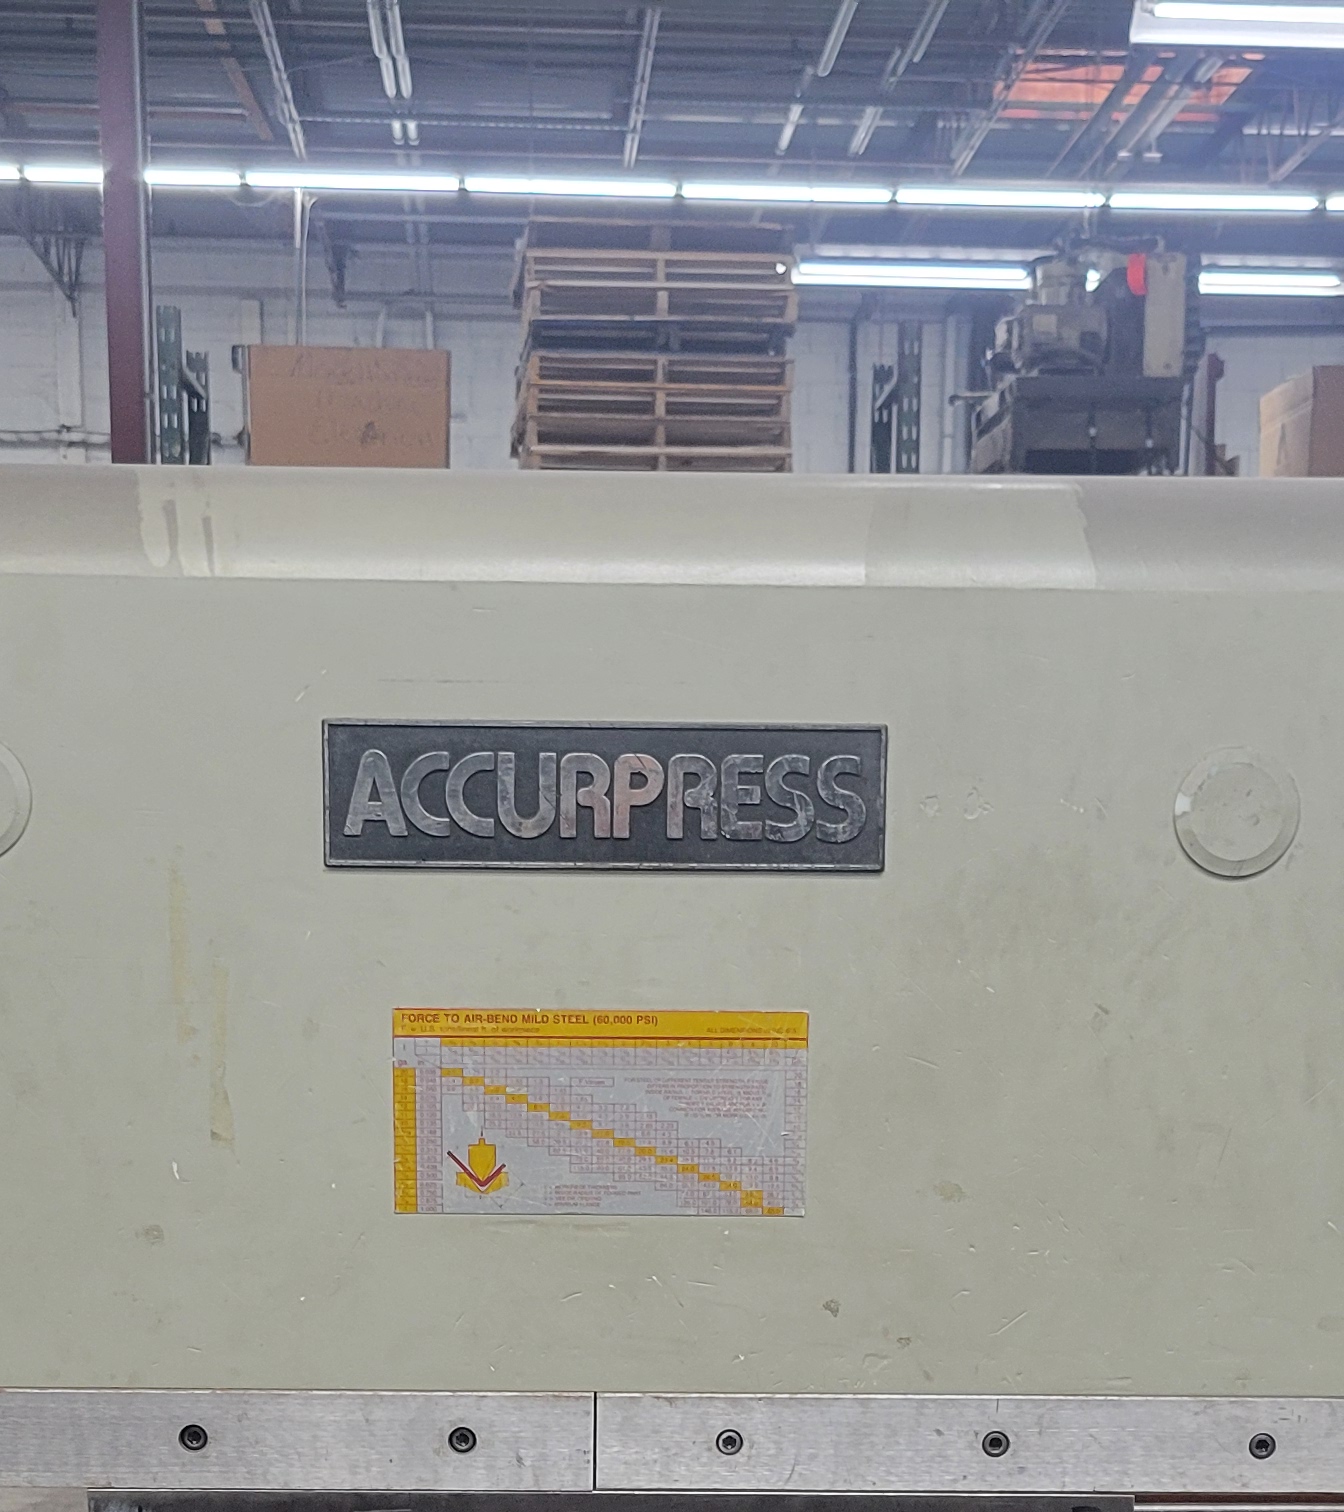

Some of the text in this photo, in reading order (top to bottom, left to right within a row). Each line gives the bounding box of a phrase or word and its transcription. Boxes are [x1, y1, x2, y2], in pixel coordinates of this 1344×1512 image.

[343, 748, 867, 843] ACCURPRESS
[401, 1013, 440, 1024] FORCE
[444, 1014, 460, 1024] TO
[464, 1014, 519, 1025] AIR-BEND
[522, 1014, 549, 1025] MILD
[553, 1014, 589, 1025] STEEL
[636, 1015, 658, 1027] PSI)
